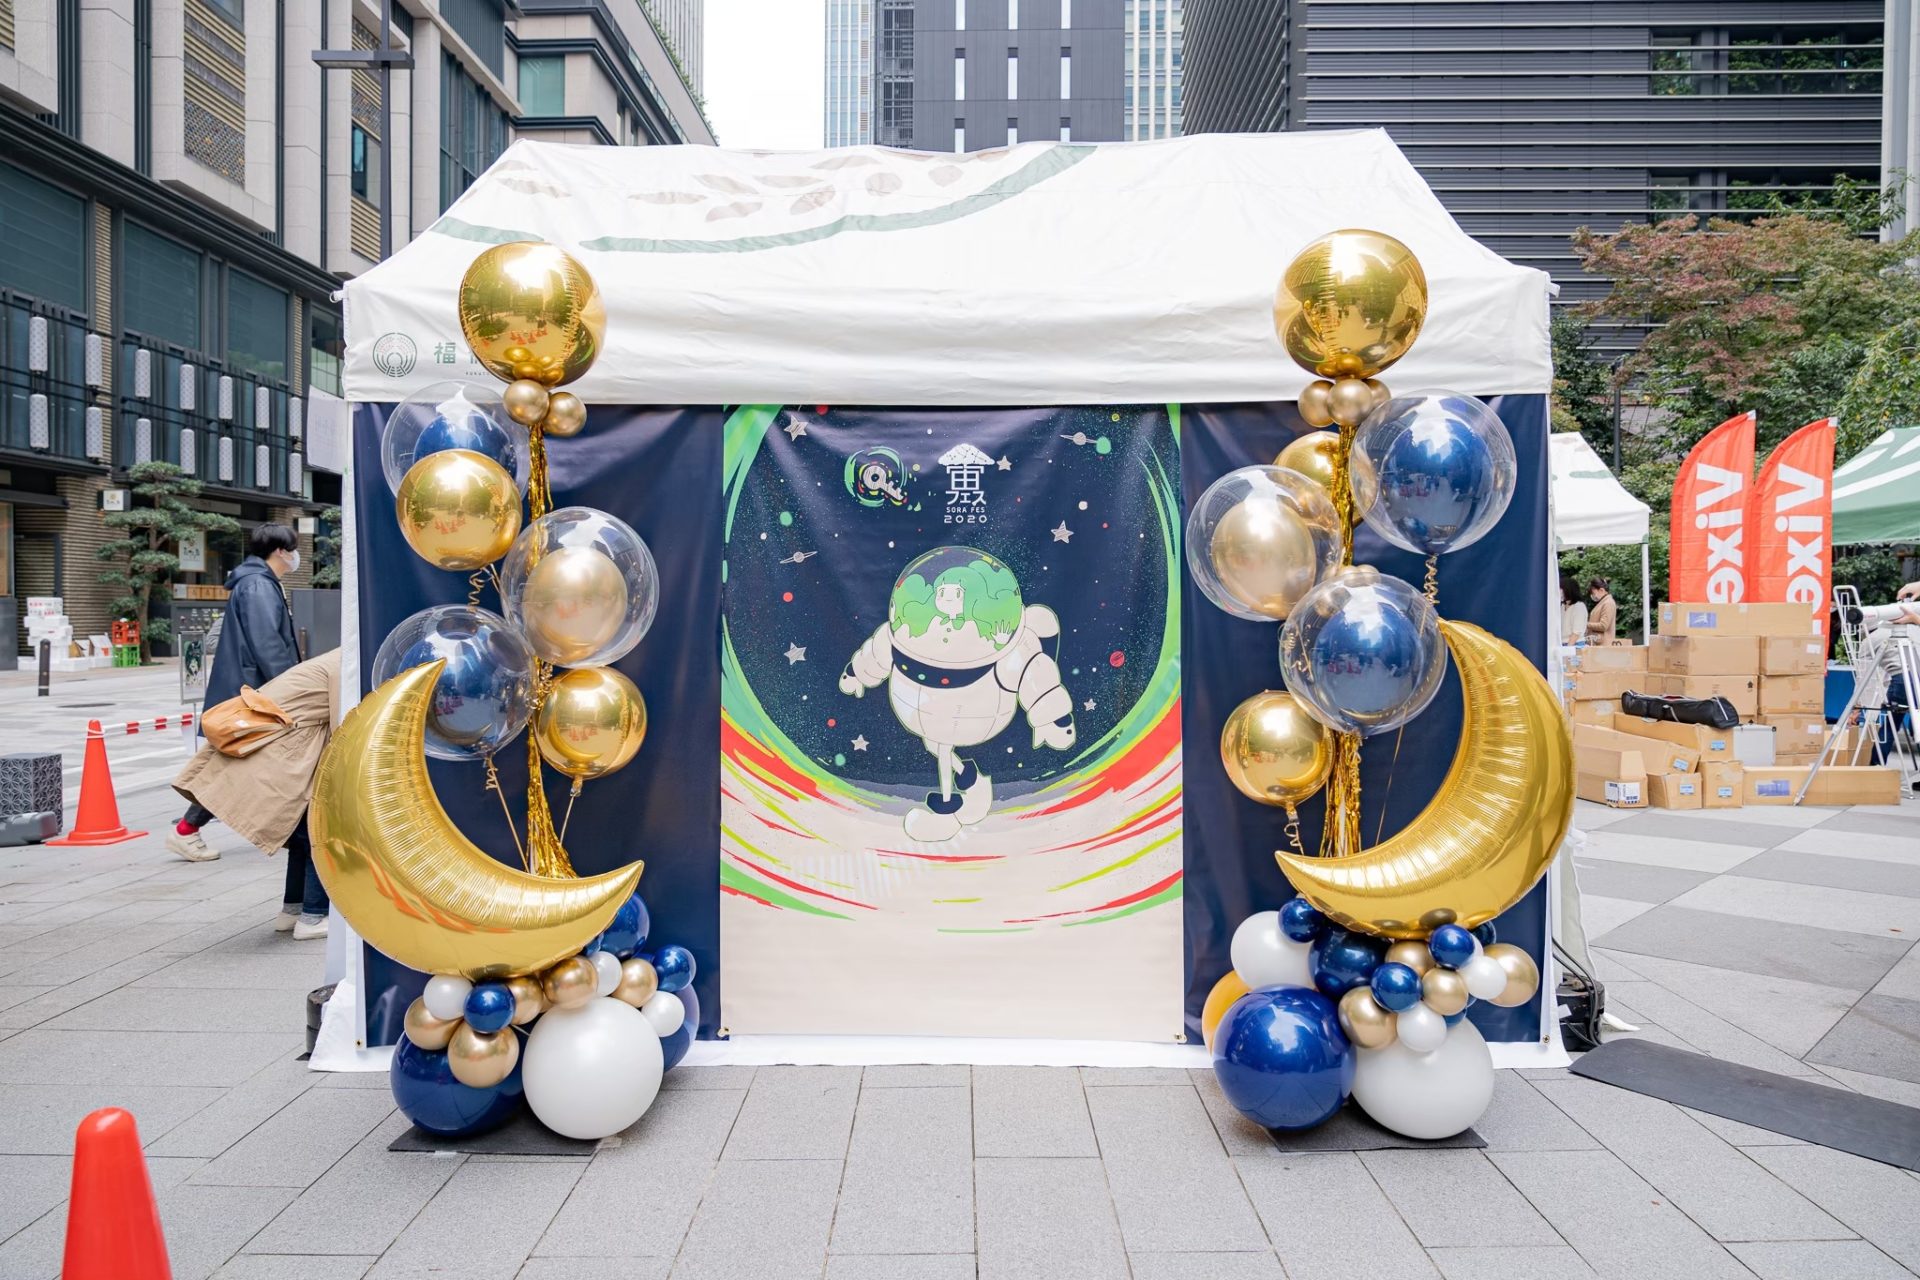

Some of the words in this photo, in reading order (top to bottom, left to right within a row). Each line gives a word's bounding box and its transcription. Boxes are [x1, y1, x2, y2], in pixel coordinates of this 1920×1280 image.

[945, 490, 987, 506] フェス
[944, 515, 987, 523] 2020
[1775, 463, 1824, 634] Vixe
